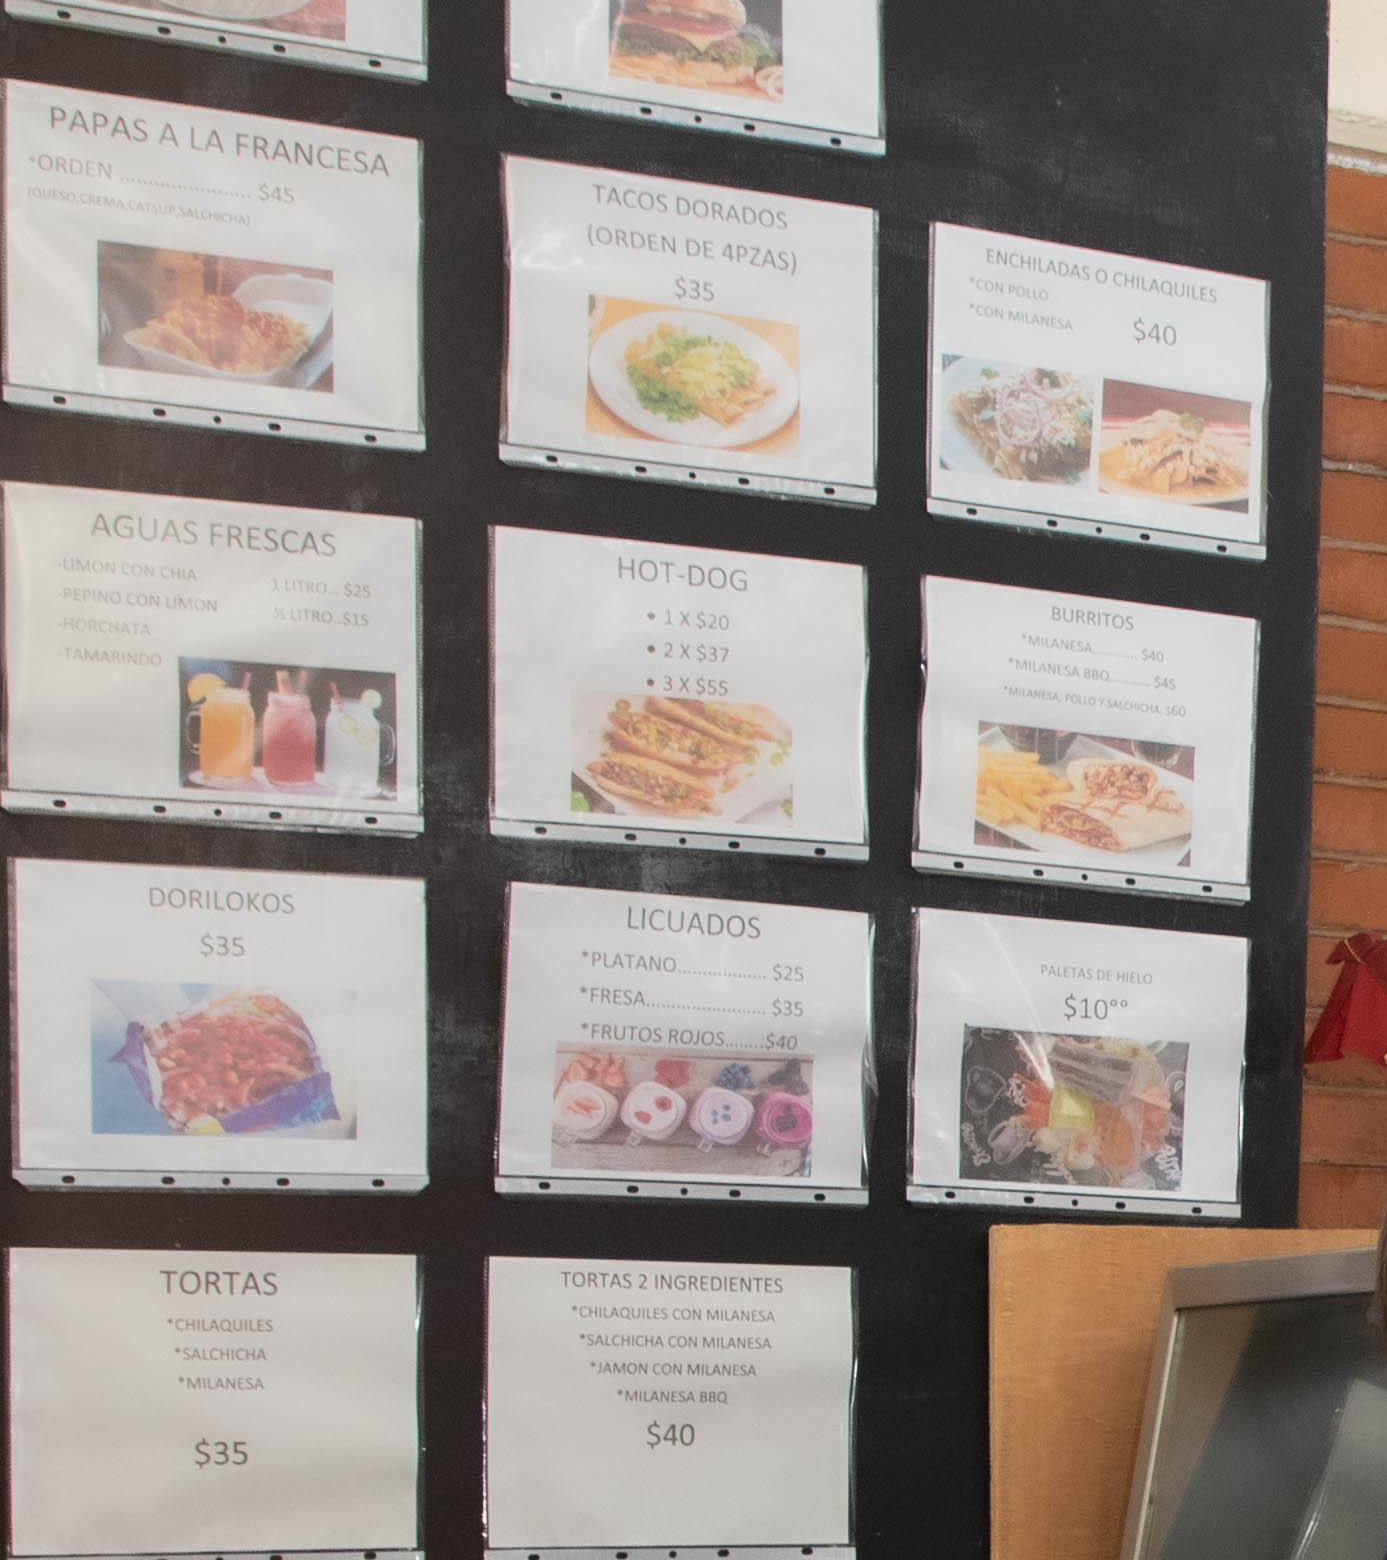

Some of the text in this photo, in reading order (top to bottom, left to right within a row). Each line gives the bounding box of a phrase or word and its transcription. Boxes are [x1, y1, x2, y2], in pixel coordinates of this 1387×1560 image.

[49, 105, 390, 177] PAPAS A LA FRANCESA
[258, 183, 295, 205] $45
[592, 184, 788, 230] TACOS DORADOS
[587, 224, 798, 276] (ORDEN DE 4PZAS)
[985, 248, 1218, 304] ENCHILADAS O CHILAQUILES
[674, 277, 715, 301] $35
[1008, 283, 1049, 302] POLLO
[1008, 310, 1073, 331] MILANESA
[1133, 317, 1177, 347] $40
[90, 512, 337, 557] AGUAS FRESCAS
[121, 562, 155, 578] CON
[160, 566, 198, 583] CHIA
[617, 556, 749, 593] HOT-DOG
[126, 591, 160, 608] CON
[343, 582, 372, 599] $25
[664, 610, 730, 631] 1 X $20
[1051, 605, 1135, 631] BURRITOS
[663, 642, 730, 664] 2 X $37
[1141, 648, 1164, 663] $40
[662, 676, 729, 697] 3 X $55
[1083, 666, 1110, 682] BBQ
[1153, 674, 1176, 690] $45
[1064, 692, 1096, 706] POLLO
[1098, 696, 1105, 707] Y
[1165, 704, 1186, 717] $60
[149, 886, 295, 915] DORILOKOS
[626, 905, 762, 939] LICUADOS
[200, 932, 246, 958] $35
[772, 963, 805, 982] $25
[1041, 964, 1153, 985] PALETAS DE HIELO
[771, 998, 804, 1018] $35
[668, 1031, 725, 1047] ROJOS
[765, 1033, 798, 1051] $40
[160, 1270, 279, 1296] TORTAS
[561, 1271, 784, 1294] TORTAS 2 INGREDIENTES
[672, 1308, 701, 1321] CON
[706, 1309, 775, 1323] MILANESA
[668, 1336, 698, 1349] CON
[702, 1337, 772, 1350] MILANESA
[652, 1362, 683, 1376] CON
[687, 1363, 756, 1377] MILANESA
[699, 1391, 728, 1405] BBQ
[646, 1420, 695, 1450] $40
[194, 1438, 249, 1468] $35
